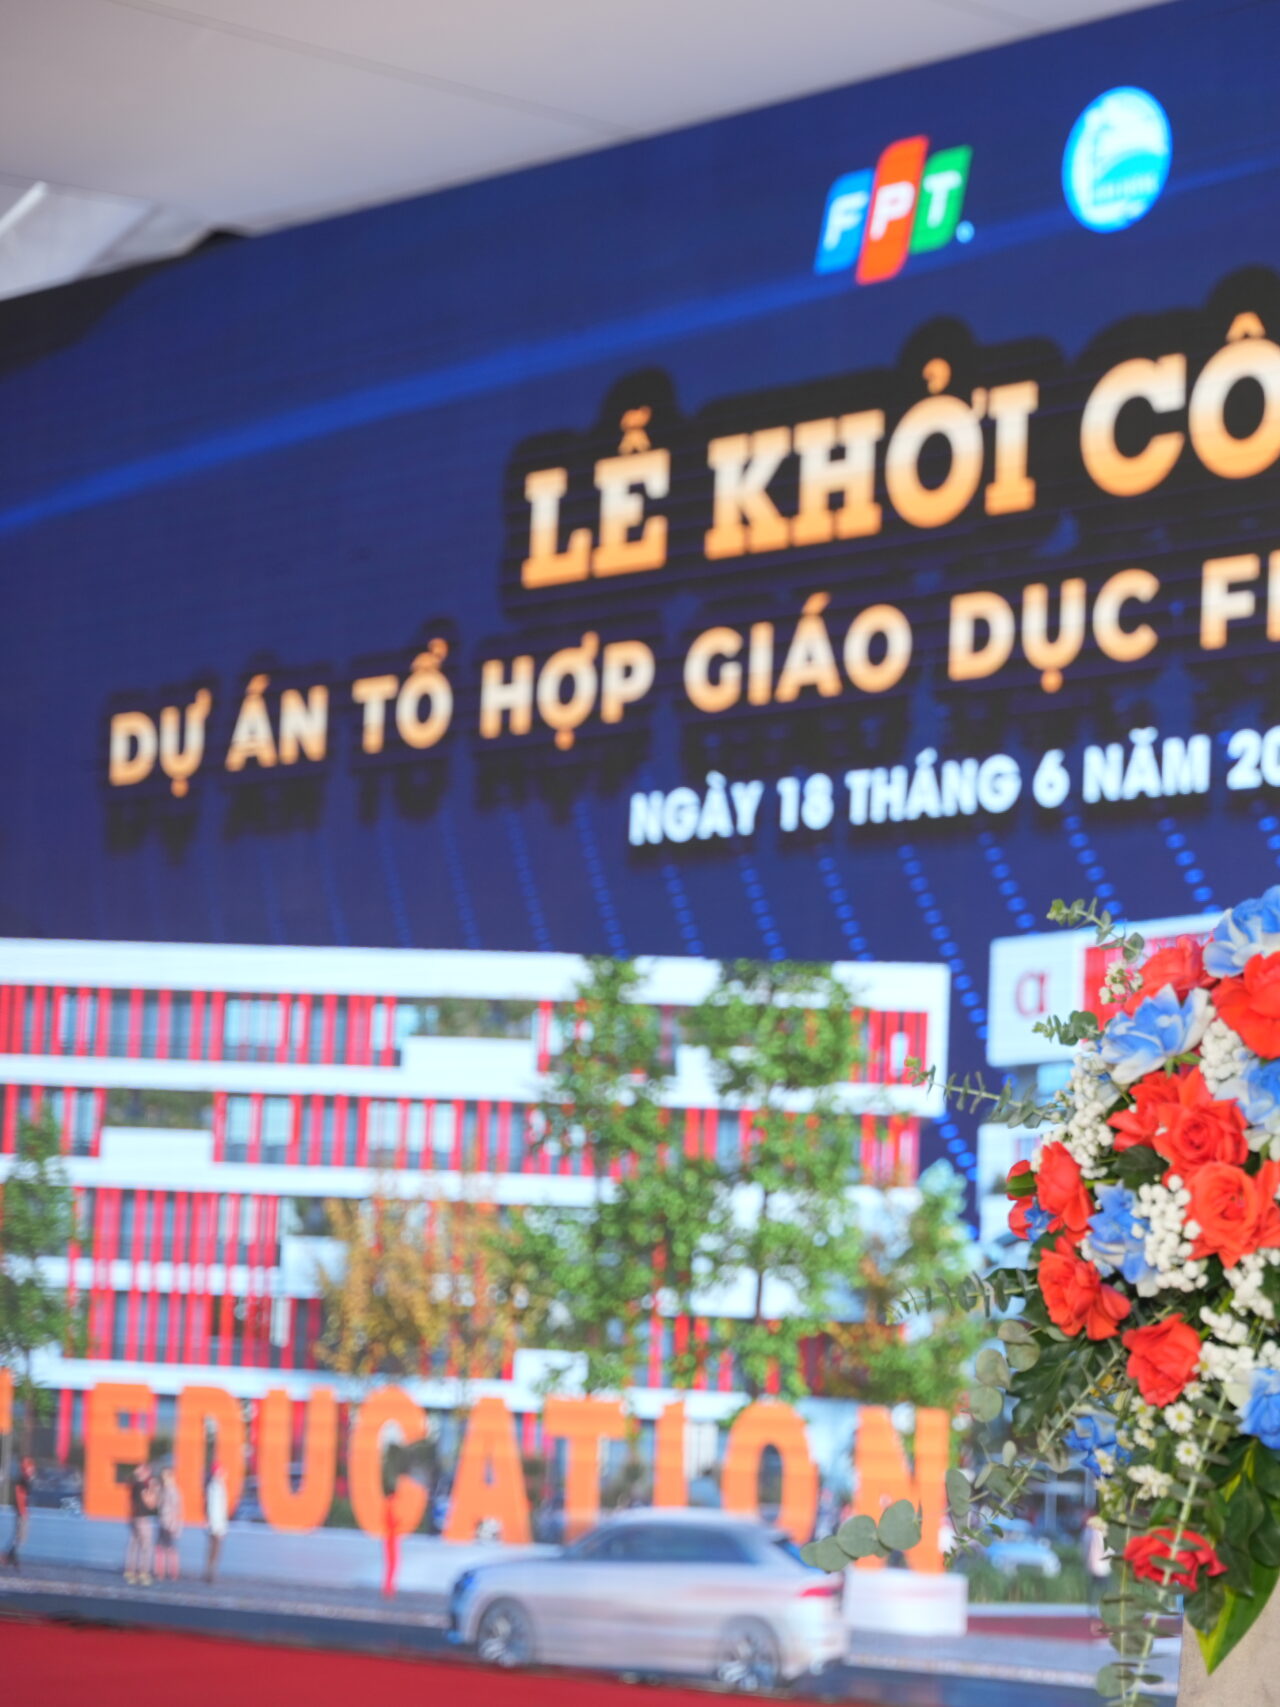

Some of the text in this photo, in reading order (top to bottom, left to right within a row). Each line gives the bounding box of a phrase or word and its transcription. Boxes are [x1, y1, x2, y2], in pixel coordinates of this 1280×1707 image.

[823, 171, 962, 250] FPT
[521, 405, 670, 589] LỄ
[704, 358, 1038, 560] KHỞI
[109, 688, 211, 797] DỰ
[226, 673, 329, 771] ÁN
[352, 637, 454, 754] TỔ
[480, 631, 655, 750] HỢP
[684, 592, 912, 713] GIÁO
[949, 568, 1160, 693] DỤC
[628, 770, 765, 846] NGÀY
[776, 773, 834, 832] 18
[845, 747, 1022, 826] THÁNG
[1033, 749, 1070, 809] 6
[1083, 726, 1211, 804] NĂM
[83, 1382, 950, 1574] EDUCATION
